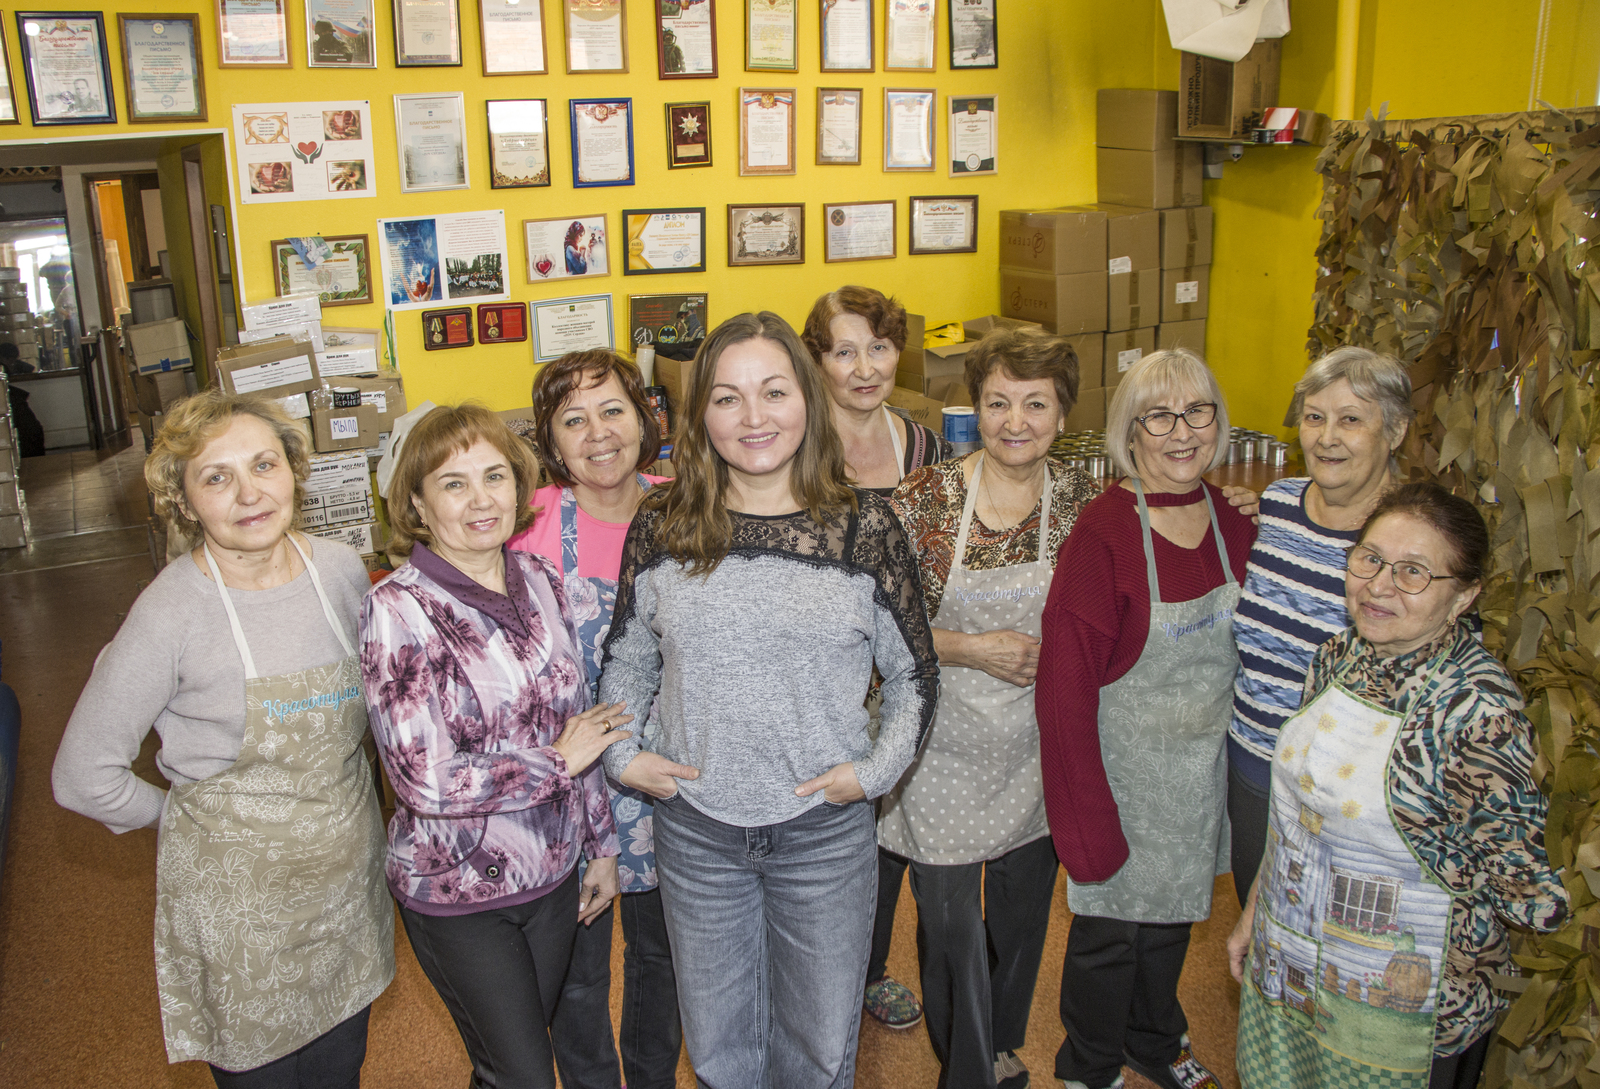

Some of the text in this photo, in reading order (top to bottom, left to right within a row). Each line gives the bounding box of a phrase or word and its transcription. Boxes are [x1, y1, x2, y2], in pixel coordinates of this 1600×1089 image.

[1008, 236, 1031, 246] СТЕРХ
[1024, 298, 1048, 309] СТЕРХ
[333, 420, 357, 432] МЫЛО
[954, 586, 1042, 606] Красотуля
[262, 686, 359, 723] Красотуля
[248, 837, 265, 848] Tea
